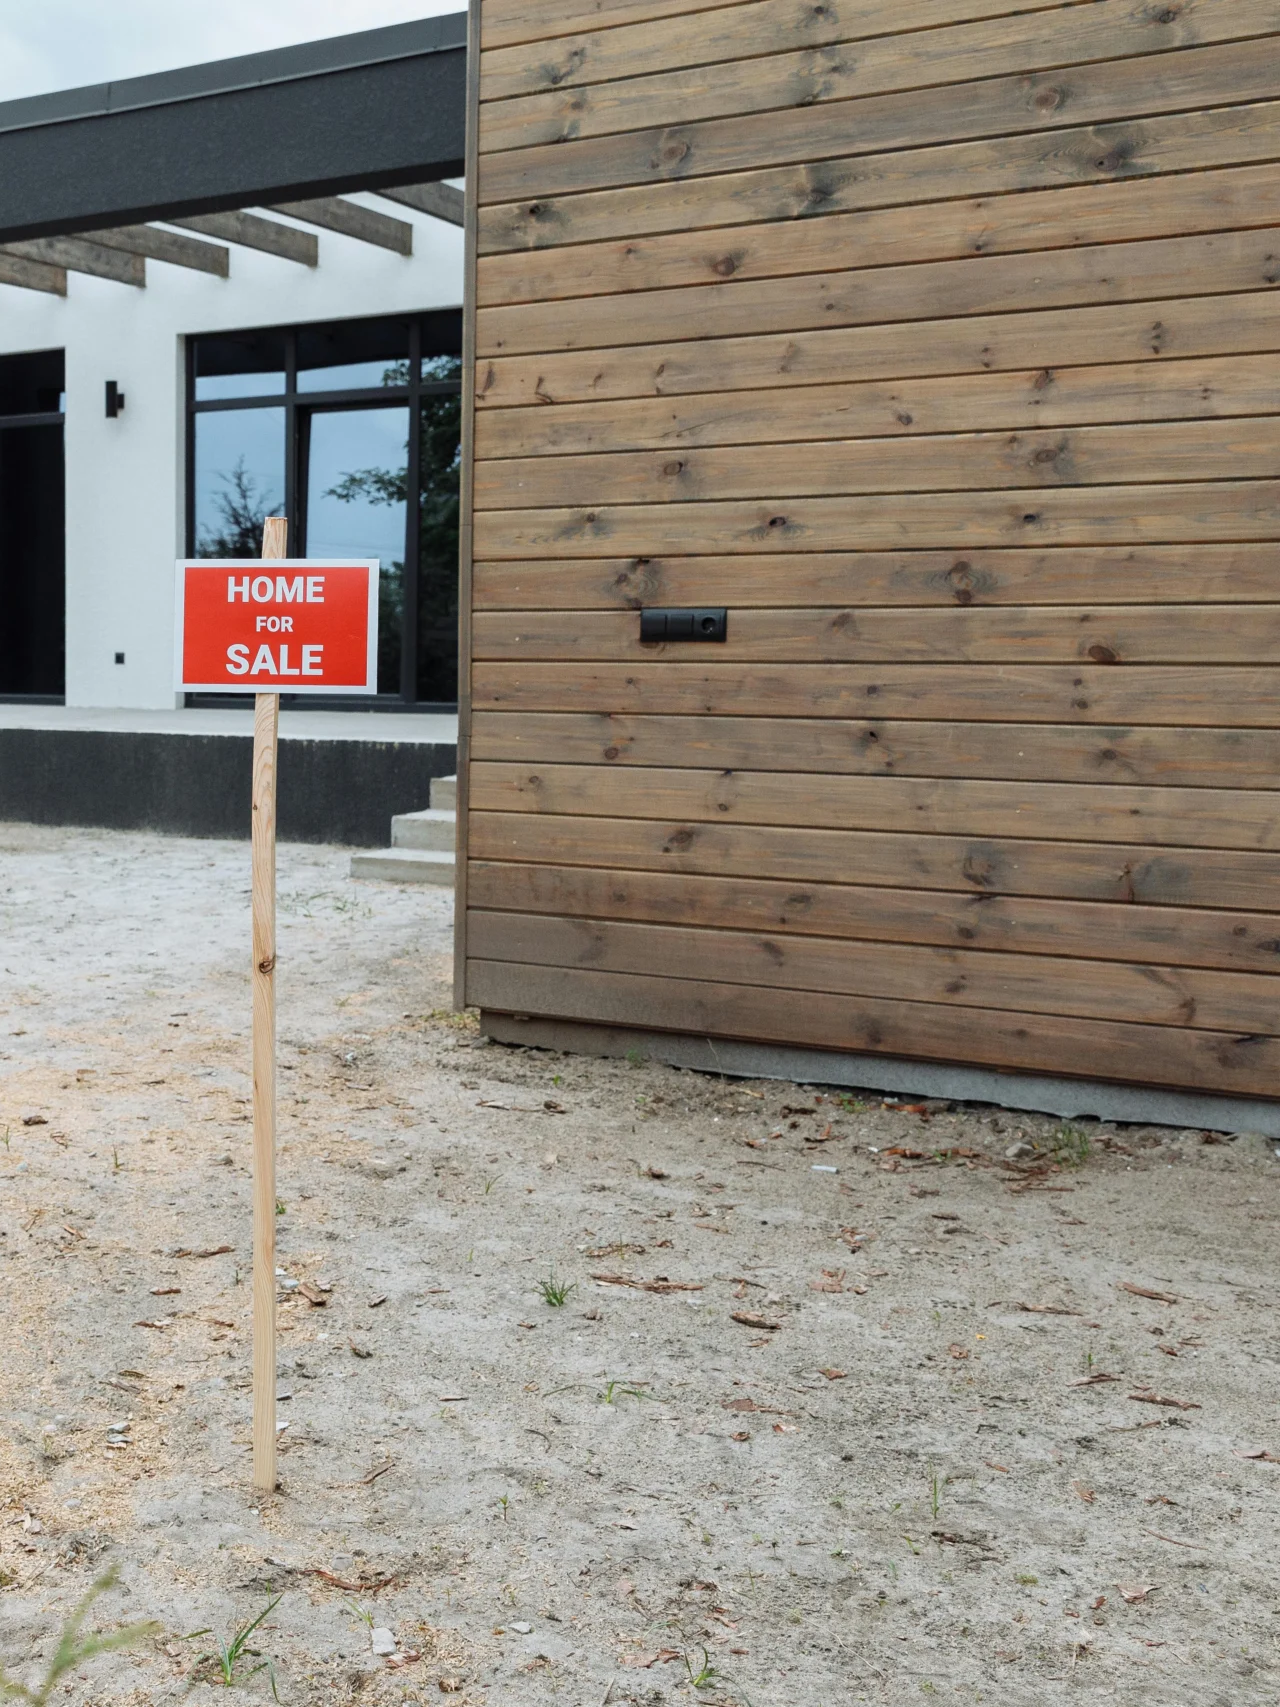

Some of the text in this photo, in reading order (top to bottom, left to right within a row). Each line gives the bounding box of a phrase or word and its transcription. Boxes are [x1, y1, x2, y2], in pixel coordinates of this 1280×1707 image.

[227, 576, 325, 603] HOME
[256, 616, 294, 632] FOR
[225, 644, 324, 676] SALE
